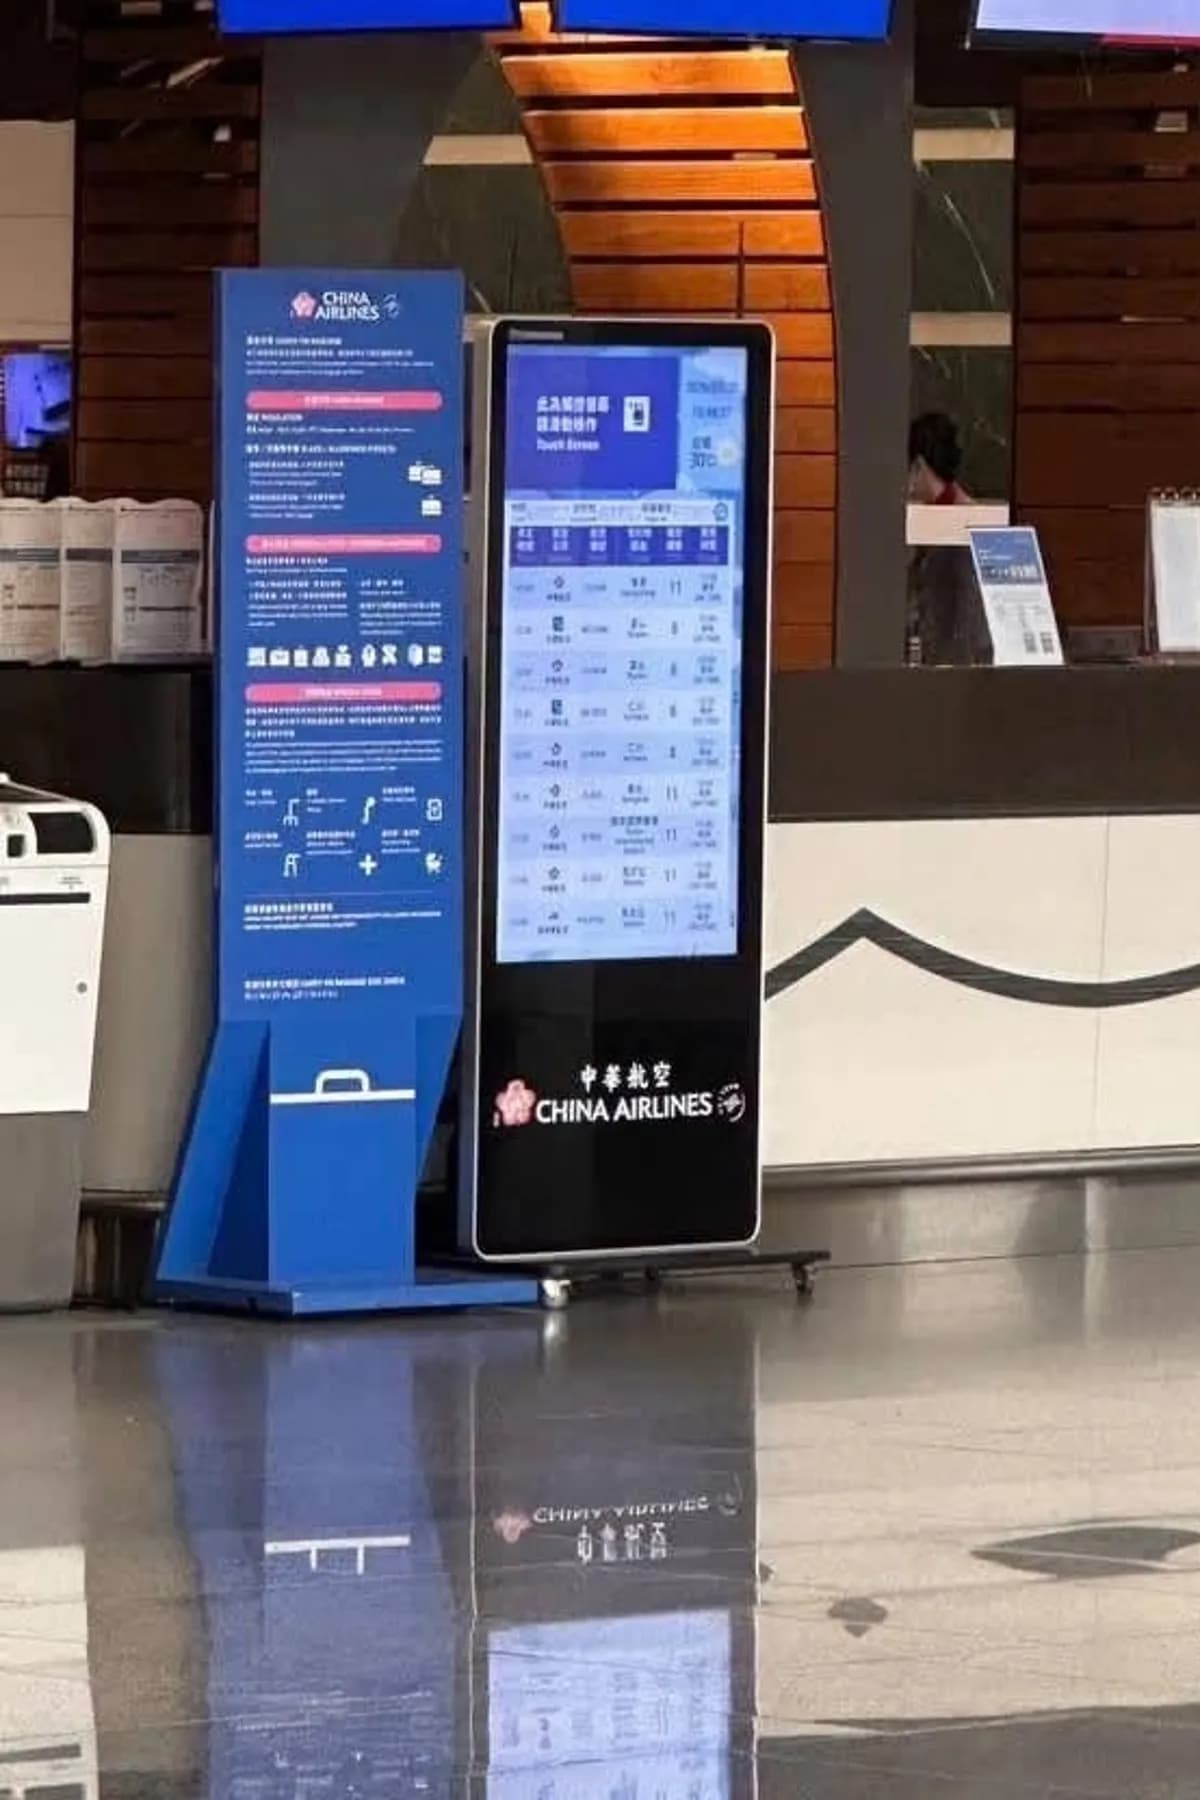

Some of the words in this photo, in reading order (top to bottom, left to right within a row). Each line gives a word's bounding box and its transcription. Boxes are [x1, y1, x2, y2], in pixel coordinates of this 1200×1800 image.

[322, 291, 370, 305] CHINA
[315, 305, 380, 320] AIRLINES
[580, 1061, 671, 1092] 中華航空
[536, 1099, 609, 1123] CHINA
[613, 1092, 713, 1121] AIRLINES
